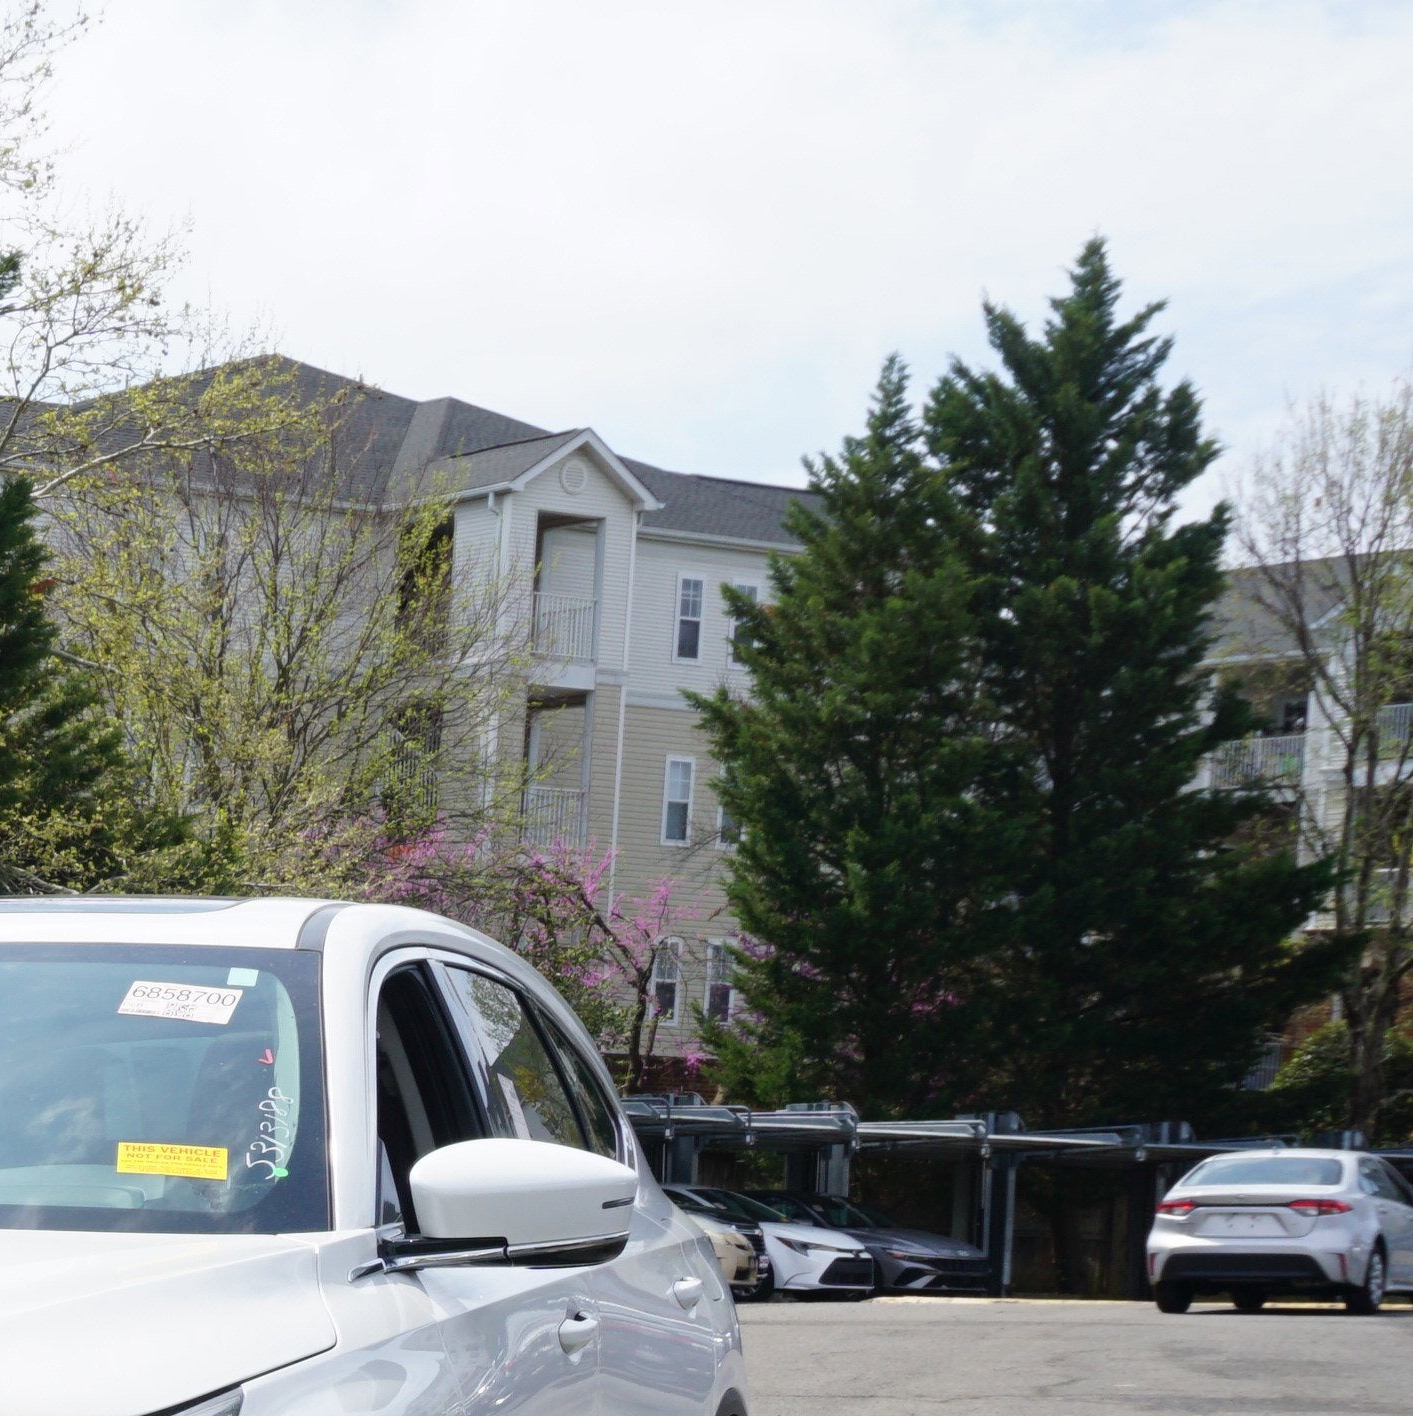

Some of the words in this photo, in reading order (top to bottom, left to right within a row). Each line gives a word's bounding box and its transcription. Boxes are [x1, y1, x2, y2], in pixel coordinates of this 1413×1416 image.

[132, 985, 237, 1007] 6858700
[124, 1144, 155, 1153] THIS
[160, 1146, 221, 1157] VEHICLE
[185, 1156, 217, 1164] SALE
